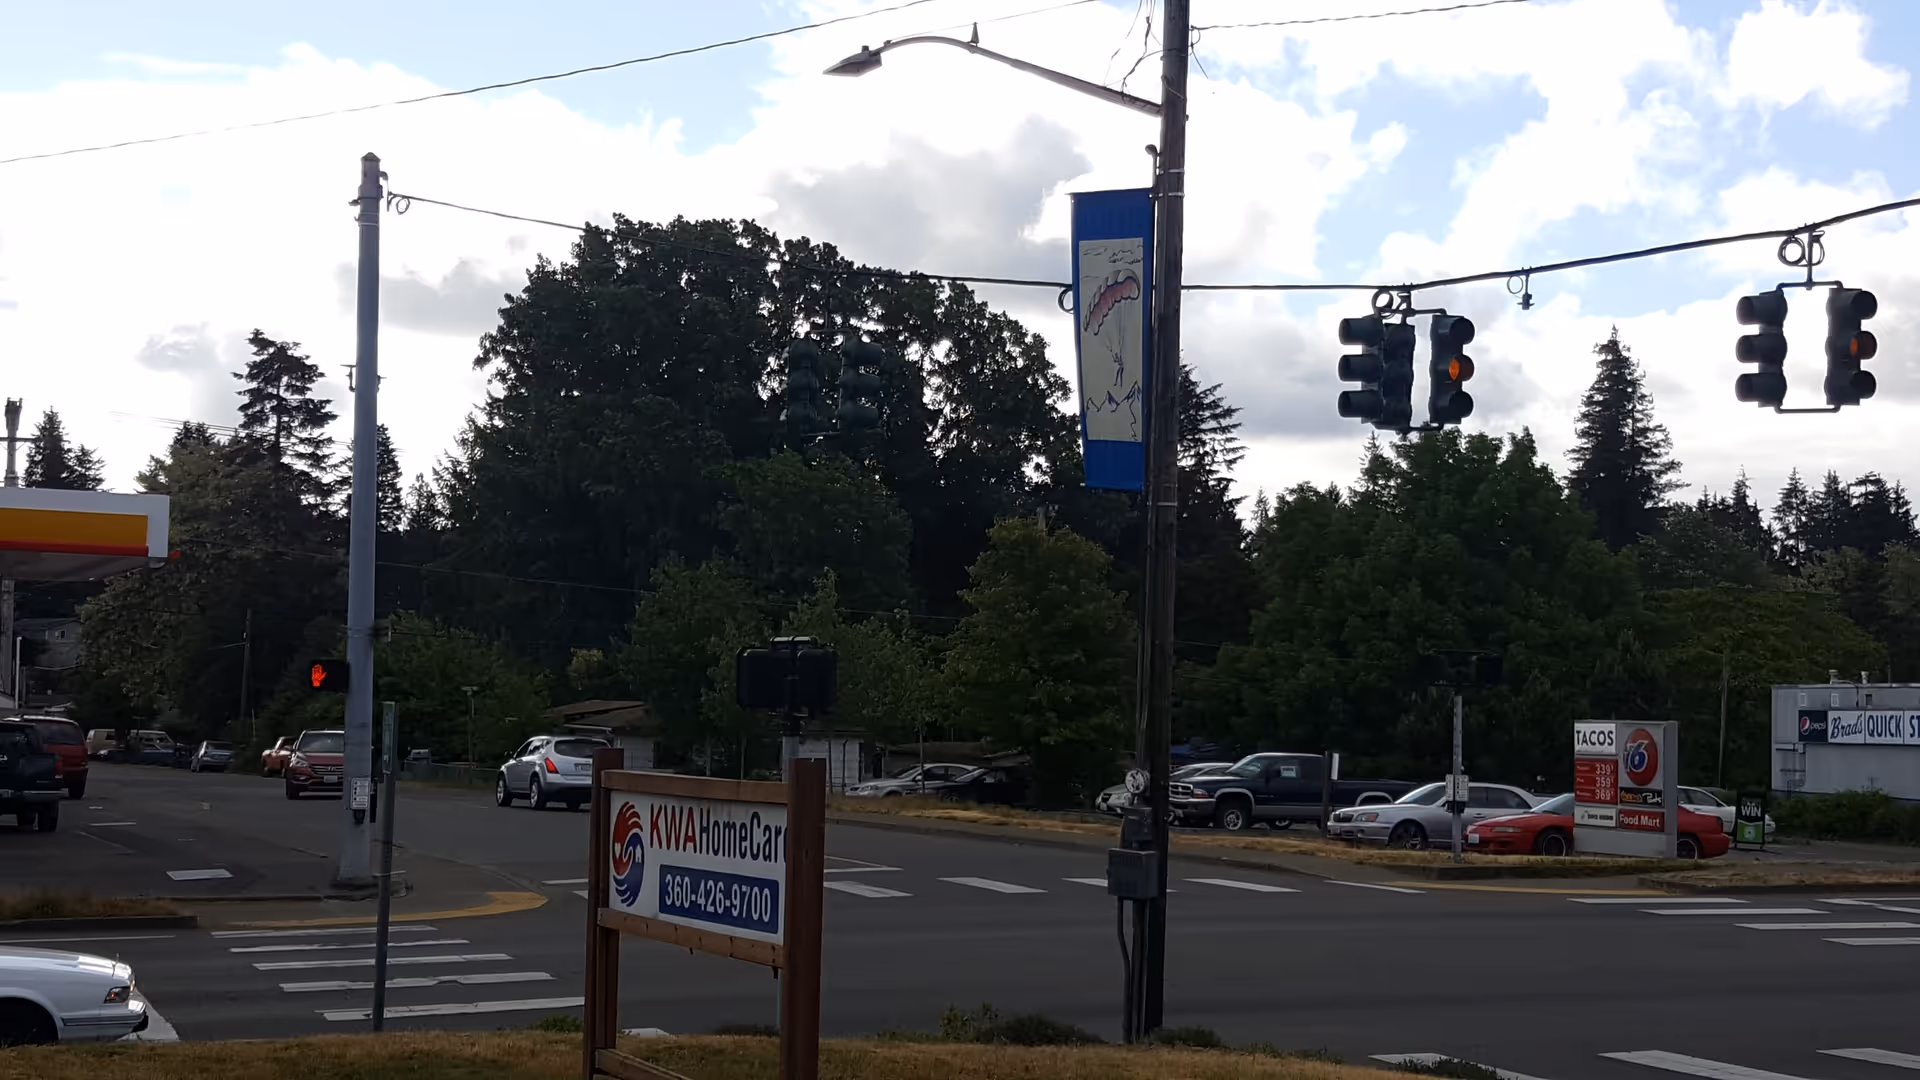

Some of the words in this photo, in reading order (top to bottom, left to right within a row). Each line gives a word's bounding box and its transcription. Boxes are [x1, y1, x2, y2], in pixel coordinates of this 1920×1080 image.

[1830, 713, 1863, 739] Brad's
[1867, 714, 1902, 738] QUICK
[1576, 730, 1614, 746] TACOS
[1620, 814, 1639, 825] Food
[1641, 815, 1660, 827] Mart
[1741, 805, 1761, 817] WIN
[650, 803, 788, 864] KWAHomeCar
[665, 873, 771, 922] 360-426-9700
